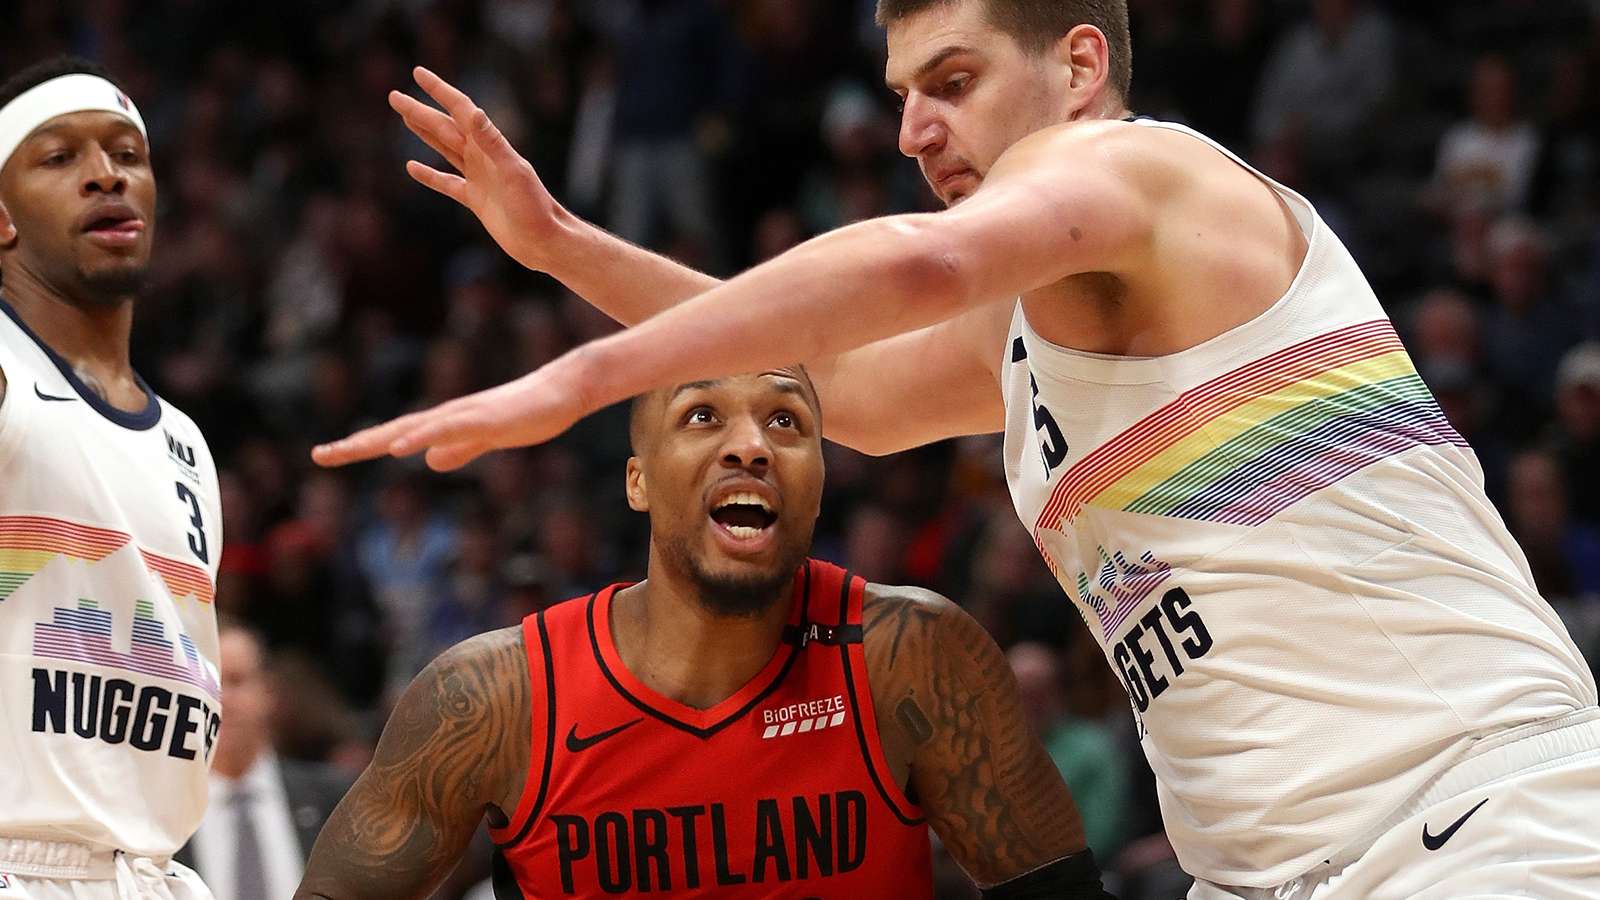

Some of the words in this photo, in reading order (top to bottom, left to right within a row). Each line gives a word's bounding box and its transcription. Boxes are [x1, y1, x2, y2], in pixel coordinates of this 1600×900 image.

[175, 481, 209, 565] 3
[1114, 583, 1213, 713] GETS
[550, 790, 866, 894] PORTLAND
